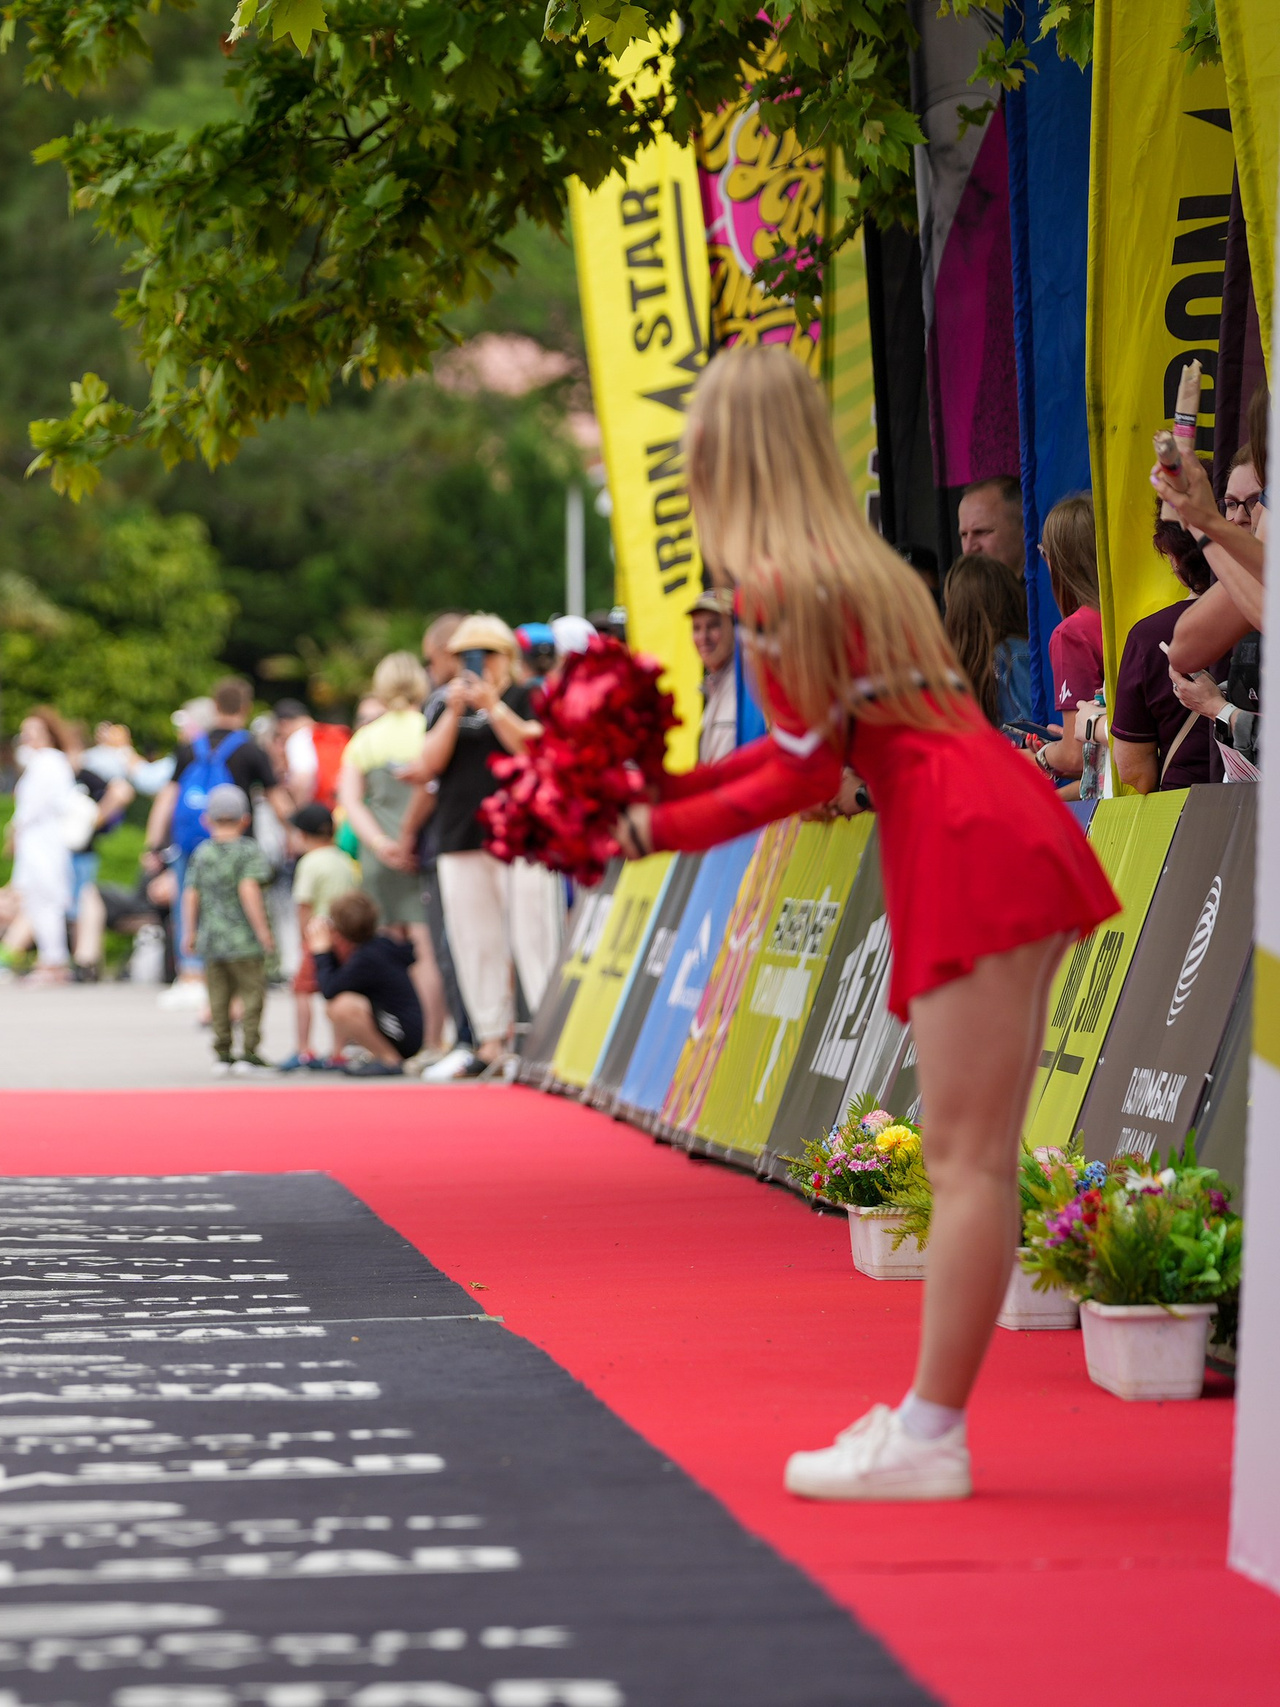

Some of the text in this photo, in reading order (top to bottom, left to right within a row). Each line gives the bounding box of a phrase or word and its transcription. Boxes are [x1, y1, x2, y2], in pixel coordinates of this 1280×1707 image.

[621, 183, 673, 356] STAR
[1073, 929, 1125, 1034] STAR
[37, 1233, 263, 1242] STAR
[44, 1272, 289, 1281] STAR
[41, 1306, 311, 1320] STAR
[41, 1325, 325, 1340] STAR
[60, 1380, 379, 1399] STAR
[77, 1452, 443, 1479] STAR
